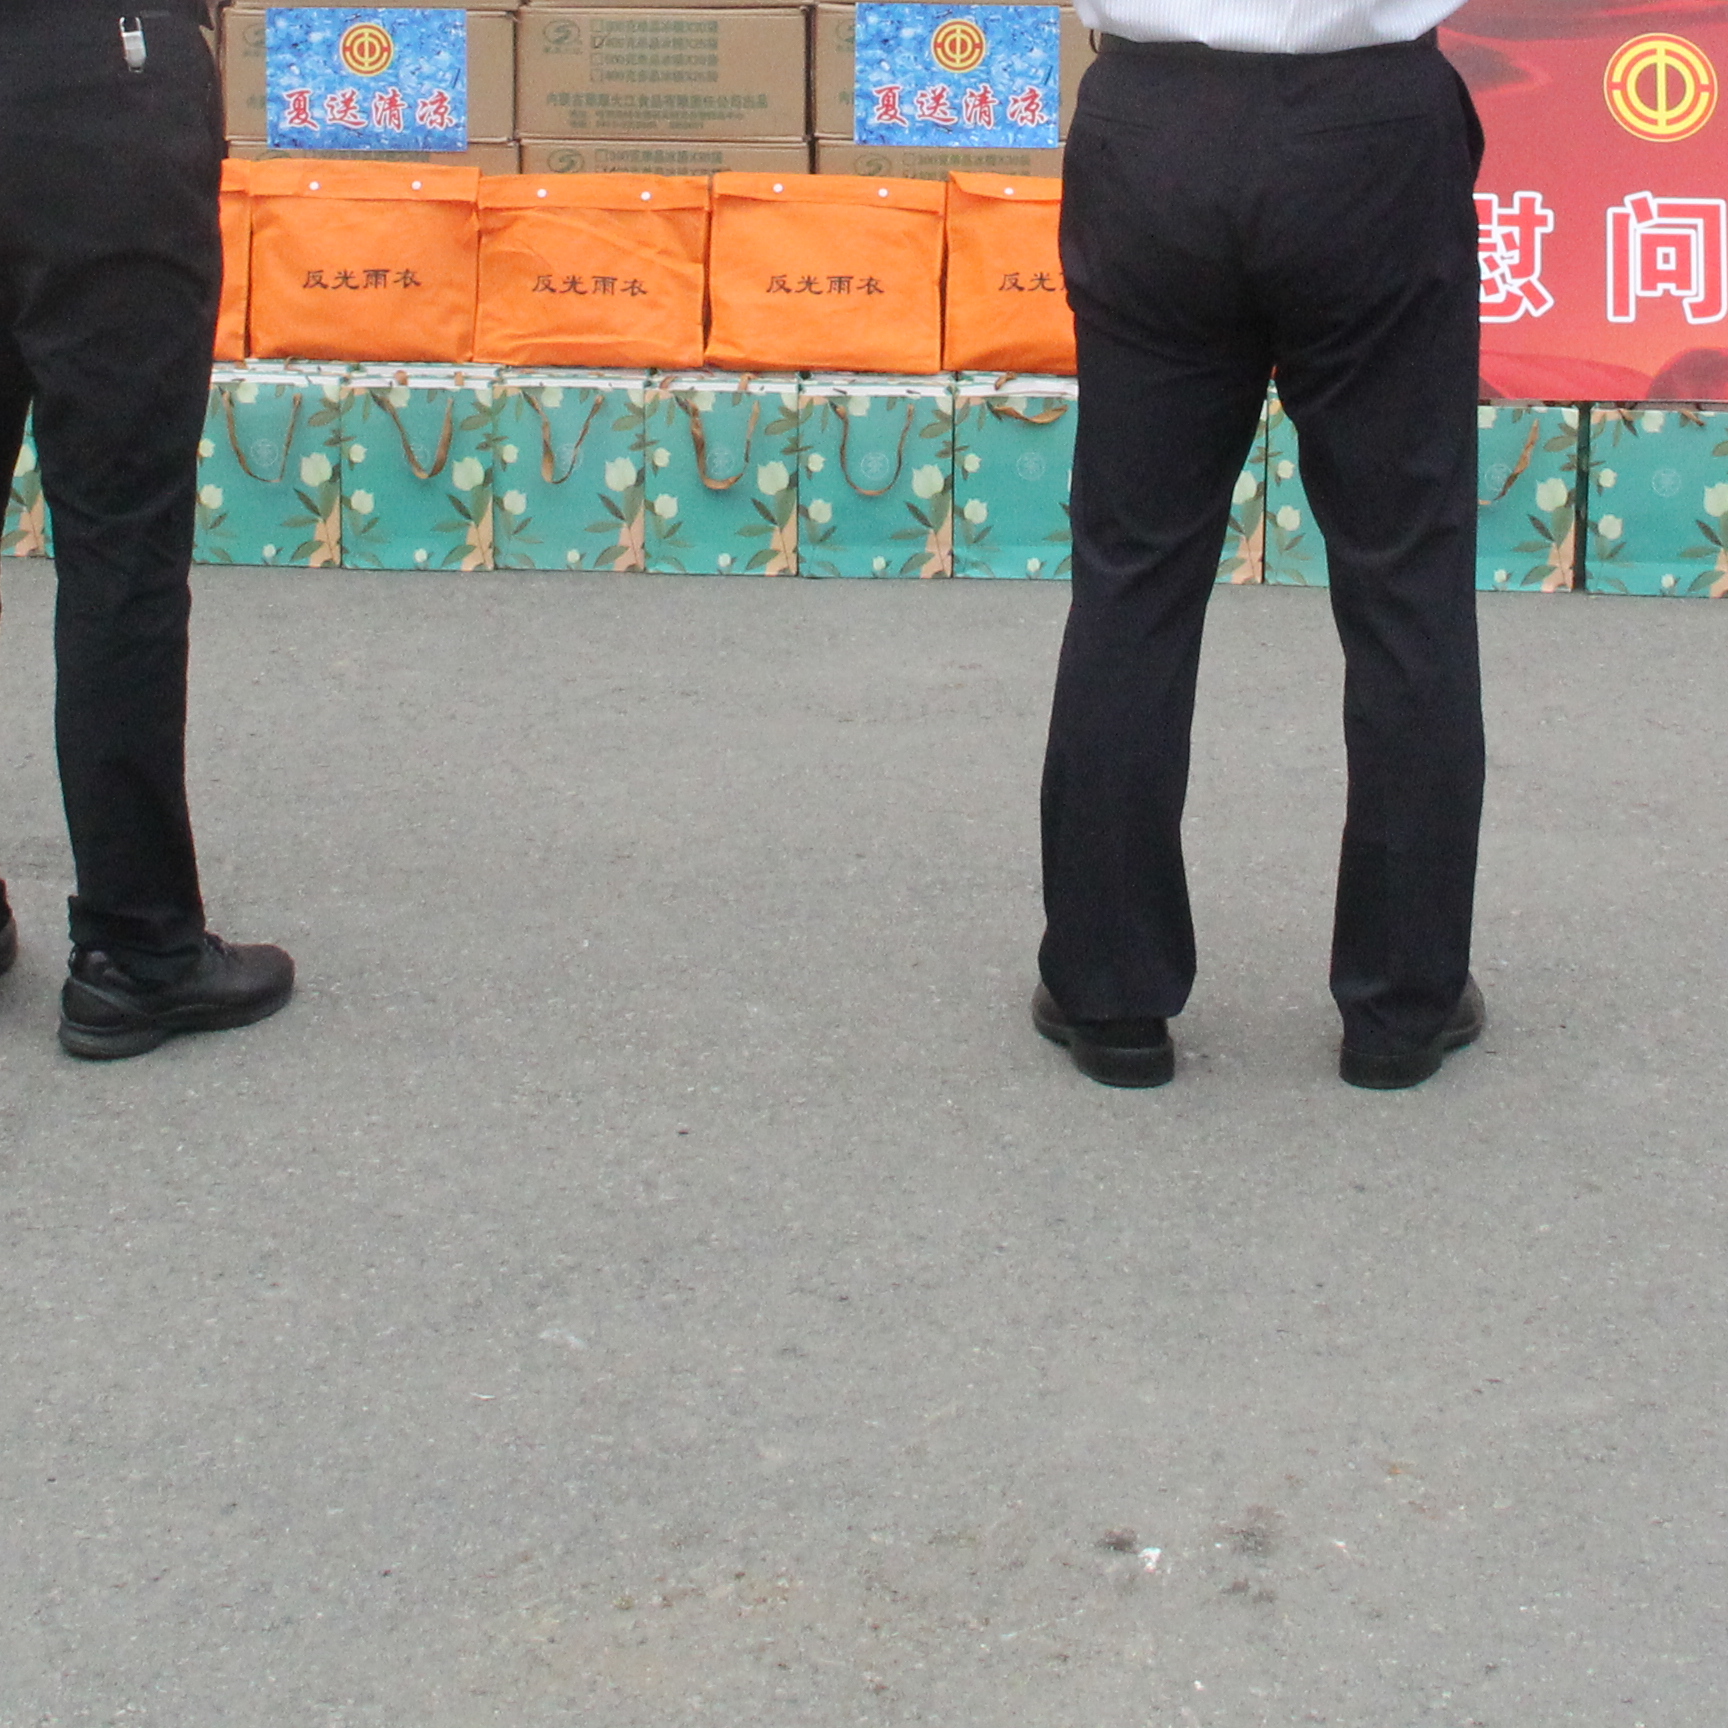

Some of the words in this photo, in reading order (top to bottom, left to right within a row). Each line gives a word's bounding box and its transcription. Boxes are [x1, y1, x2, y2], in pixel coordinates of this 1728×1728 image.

[282, 87, 456, 133] 夏送清凉
[872, 83, 1049, 129] 夏送清凉
[301, 268, 423, 291] 反光雨衣
[530, 273, 650, 298] 反光雨衣
[765, 273, 886, 296] 反光雨衣
